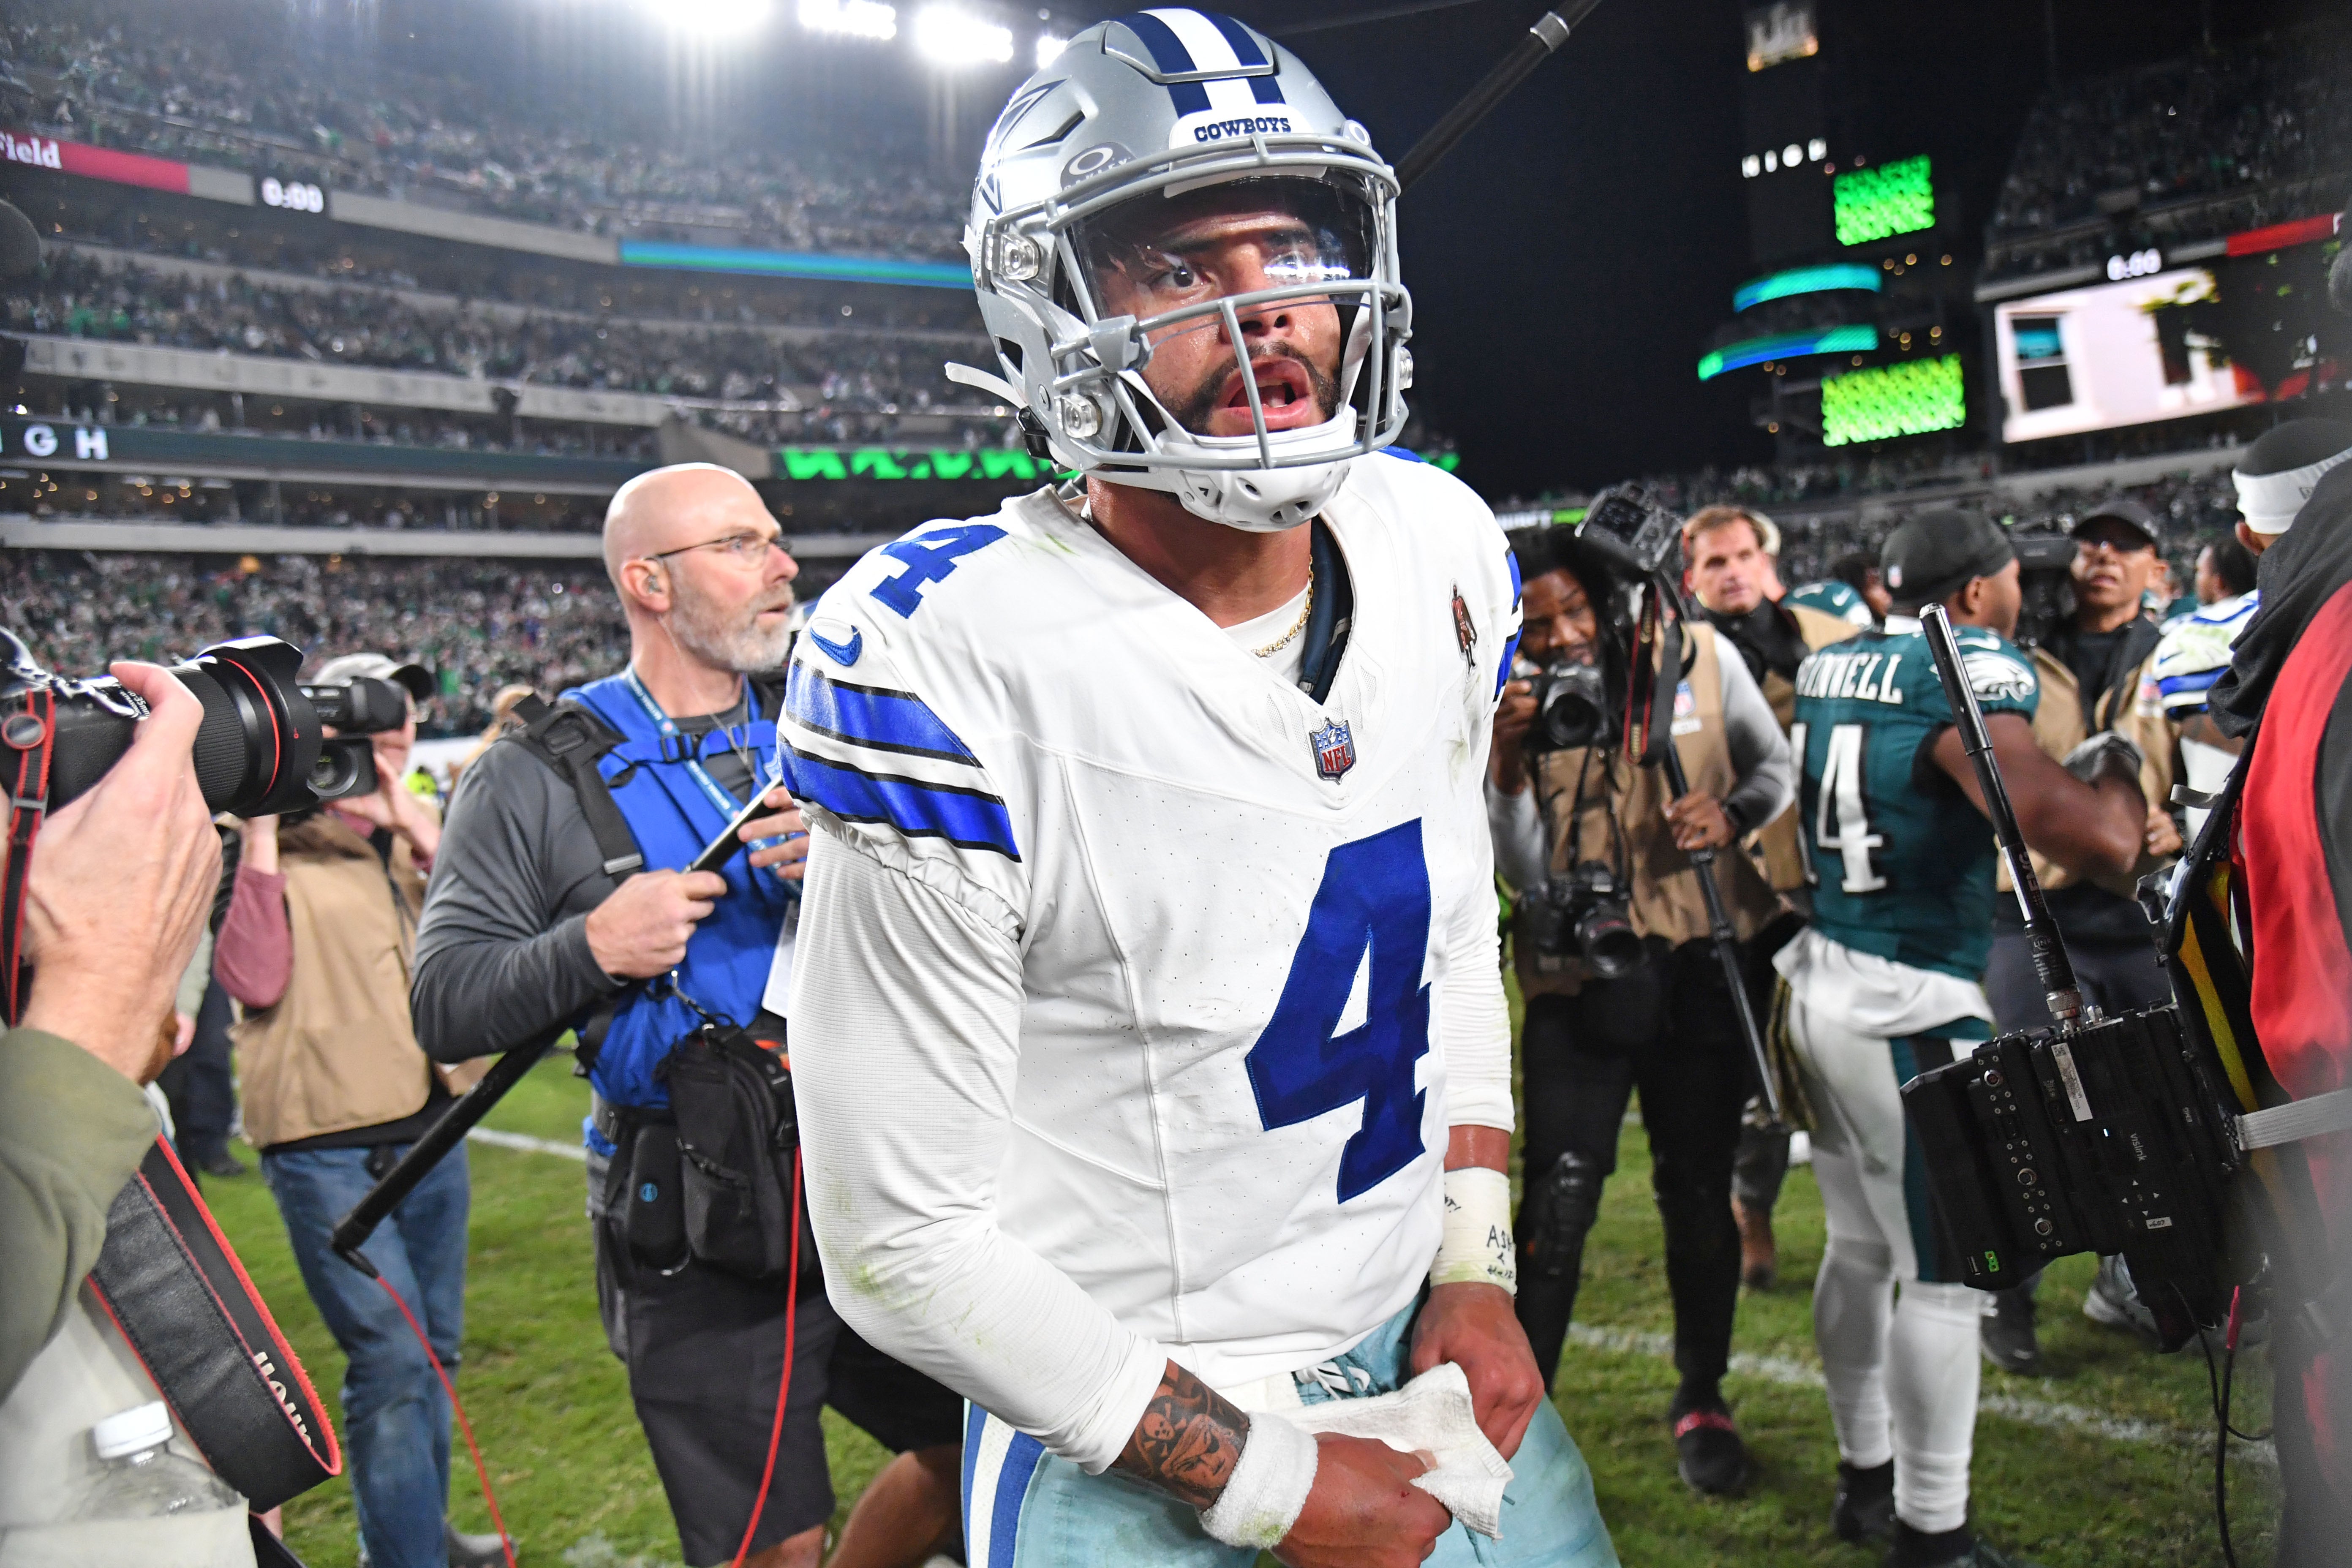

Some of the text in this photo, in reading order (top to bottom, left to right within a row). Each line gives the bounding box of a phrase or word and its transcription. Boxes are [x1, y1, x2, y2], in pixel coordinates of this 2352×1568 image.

[1194, 117, 1291, 142] COWBOYS
[261, 177, 324, 213] 0:00
[869, 524, 1009, 619] 4
[1321, 744, 1352, 772] NFL
[1245, 817, 1432, 1205] 4
[2130, 1132, 2147, 1162] vislink
